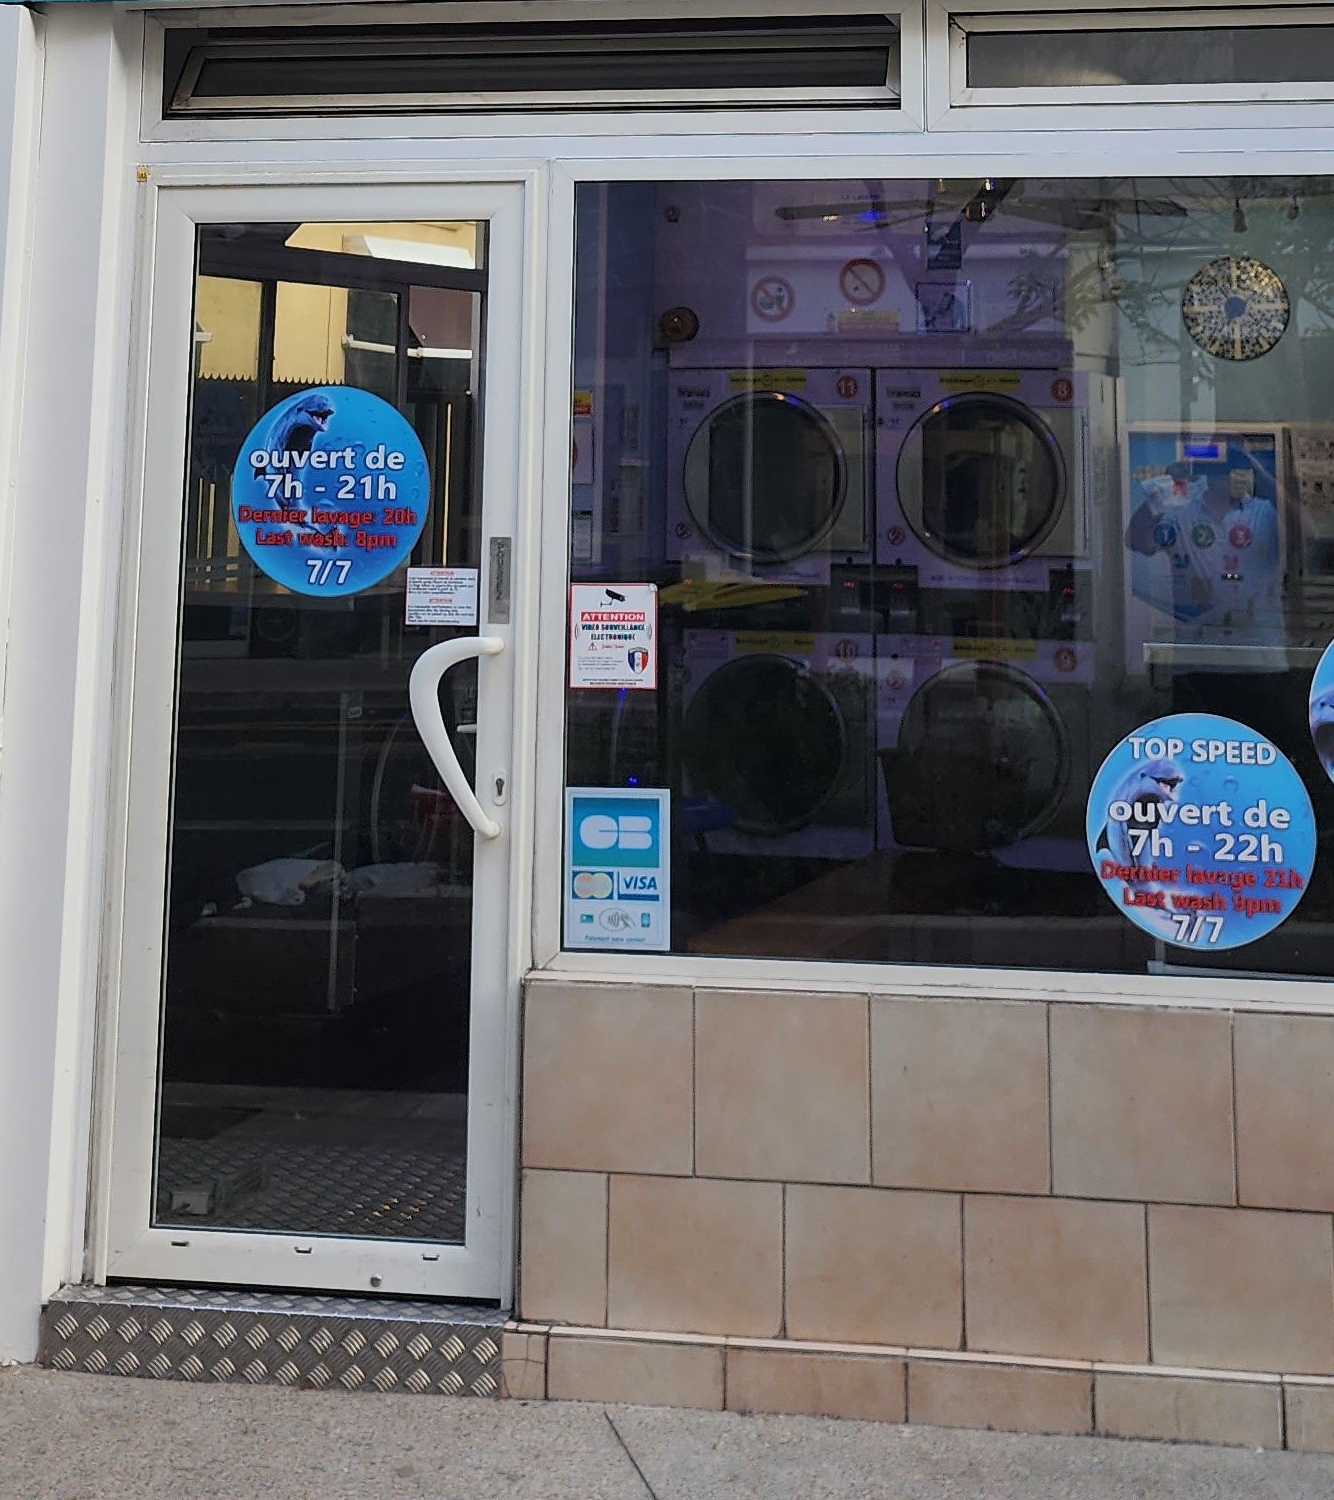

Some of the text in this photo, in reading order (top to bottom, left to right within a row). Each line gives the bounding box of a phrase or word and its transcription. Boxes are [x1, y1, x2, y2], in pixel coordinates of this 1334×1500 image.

[249, 444, 405, 470] ouvert de
[265, 473, 303, 499] 7h
[337, 474, 397, 500] 21h
[238, 504, 306, 524] Dernier
[382, 507, 418, 525] 20h
[255, 528, 293, 546] Last
[355, 531, 398, 552] 8pm
[306, 559, 353, 585] 7/7
[582, 613, 644, 621] ATTENTION
[1128, 737, 1277, 766] TOP SPEED
[1109, 799, 1292, 830] ouvert de
[579, 814, 653, 850] CB
[1127, 828, 1173, 858] 7h
[1213, 833, 1284, 863] 22h
[623, 875, 658, 891] VISA
[1100, 860, 1304, 891] Dernier lavage 21h
[1122, 887, 1283, 918] Last wash 9pm
[1172, 915, 1225, 943] 7/7
